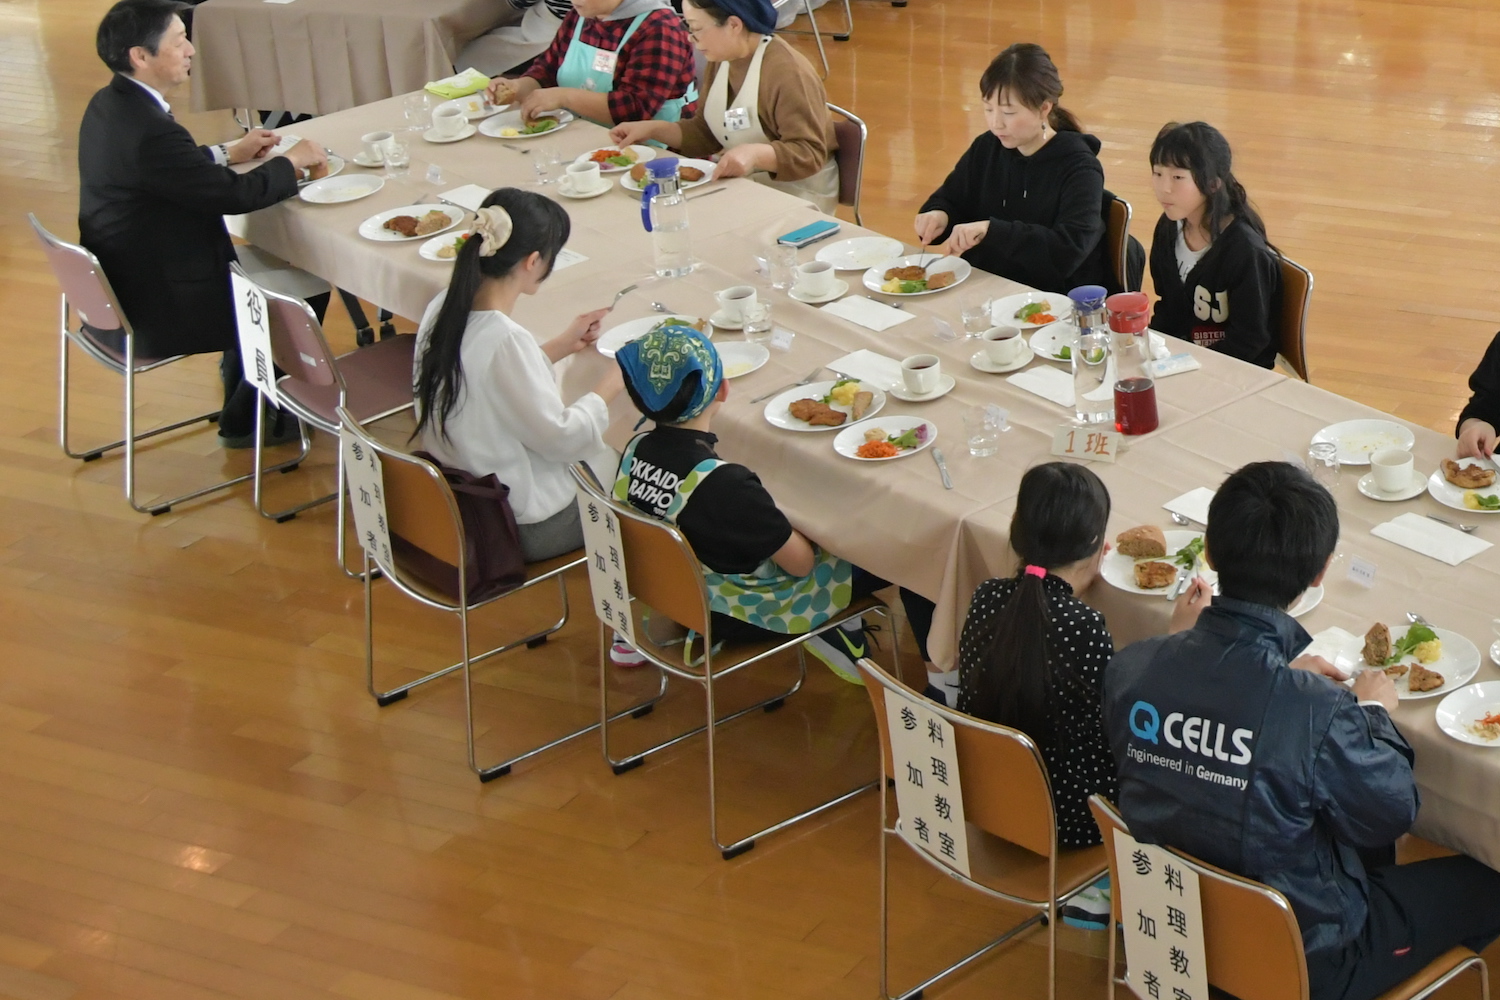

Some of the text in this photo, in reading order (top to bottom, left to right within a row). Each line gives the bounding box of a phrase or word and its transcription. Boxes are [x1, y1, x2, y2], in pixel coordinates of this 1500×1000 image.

[1193, 284, 1229, 324] SJ
[1194, 332, 1226, 340] SISTER
[1065, 430, 1110, 455] 1班
[1128, 700, 1253, 766] Q CELLS
[900, 706, 930, 844] 参加者
[927, 718, 957, 861] 料理教室
[1127, 742, 1249, 791] Engineered in Germany
[1132, 849, 1162, 1000] 参加者
